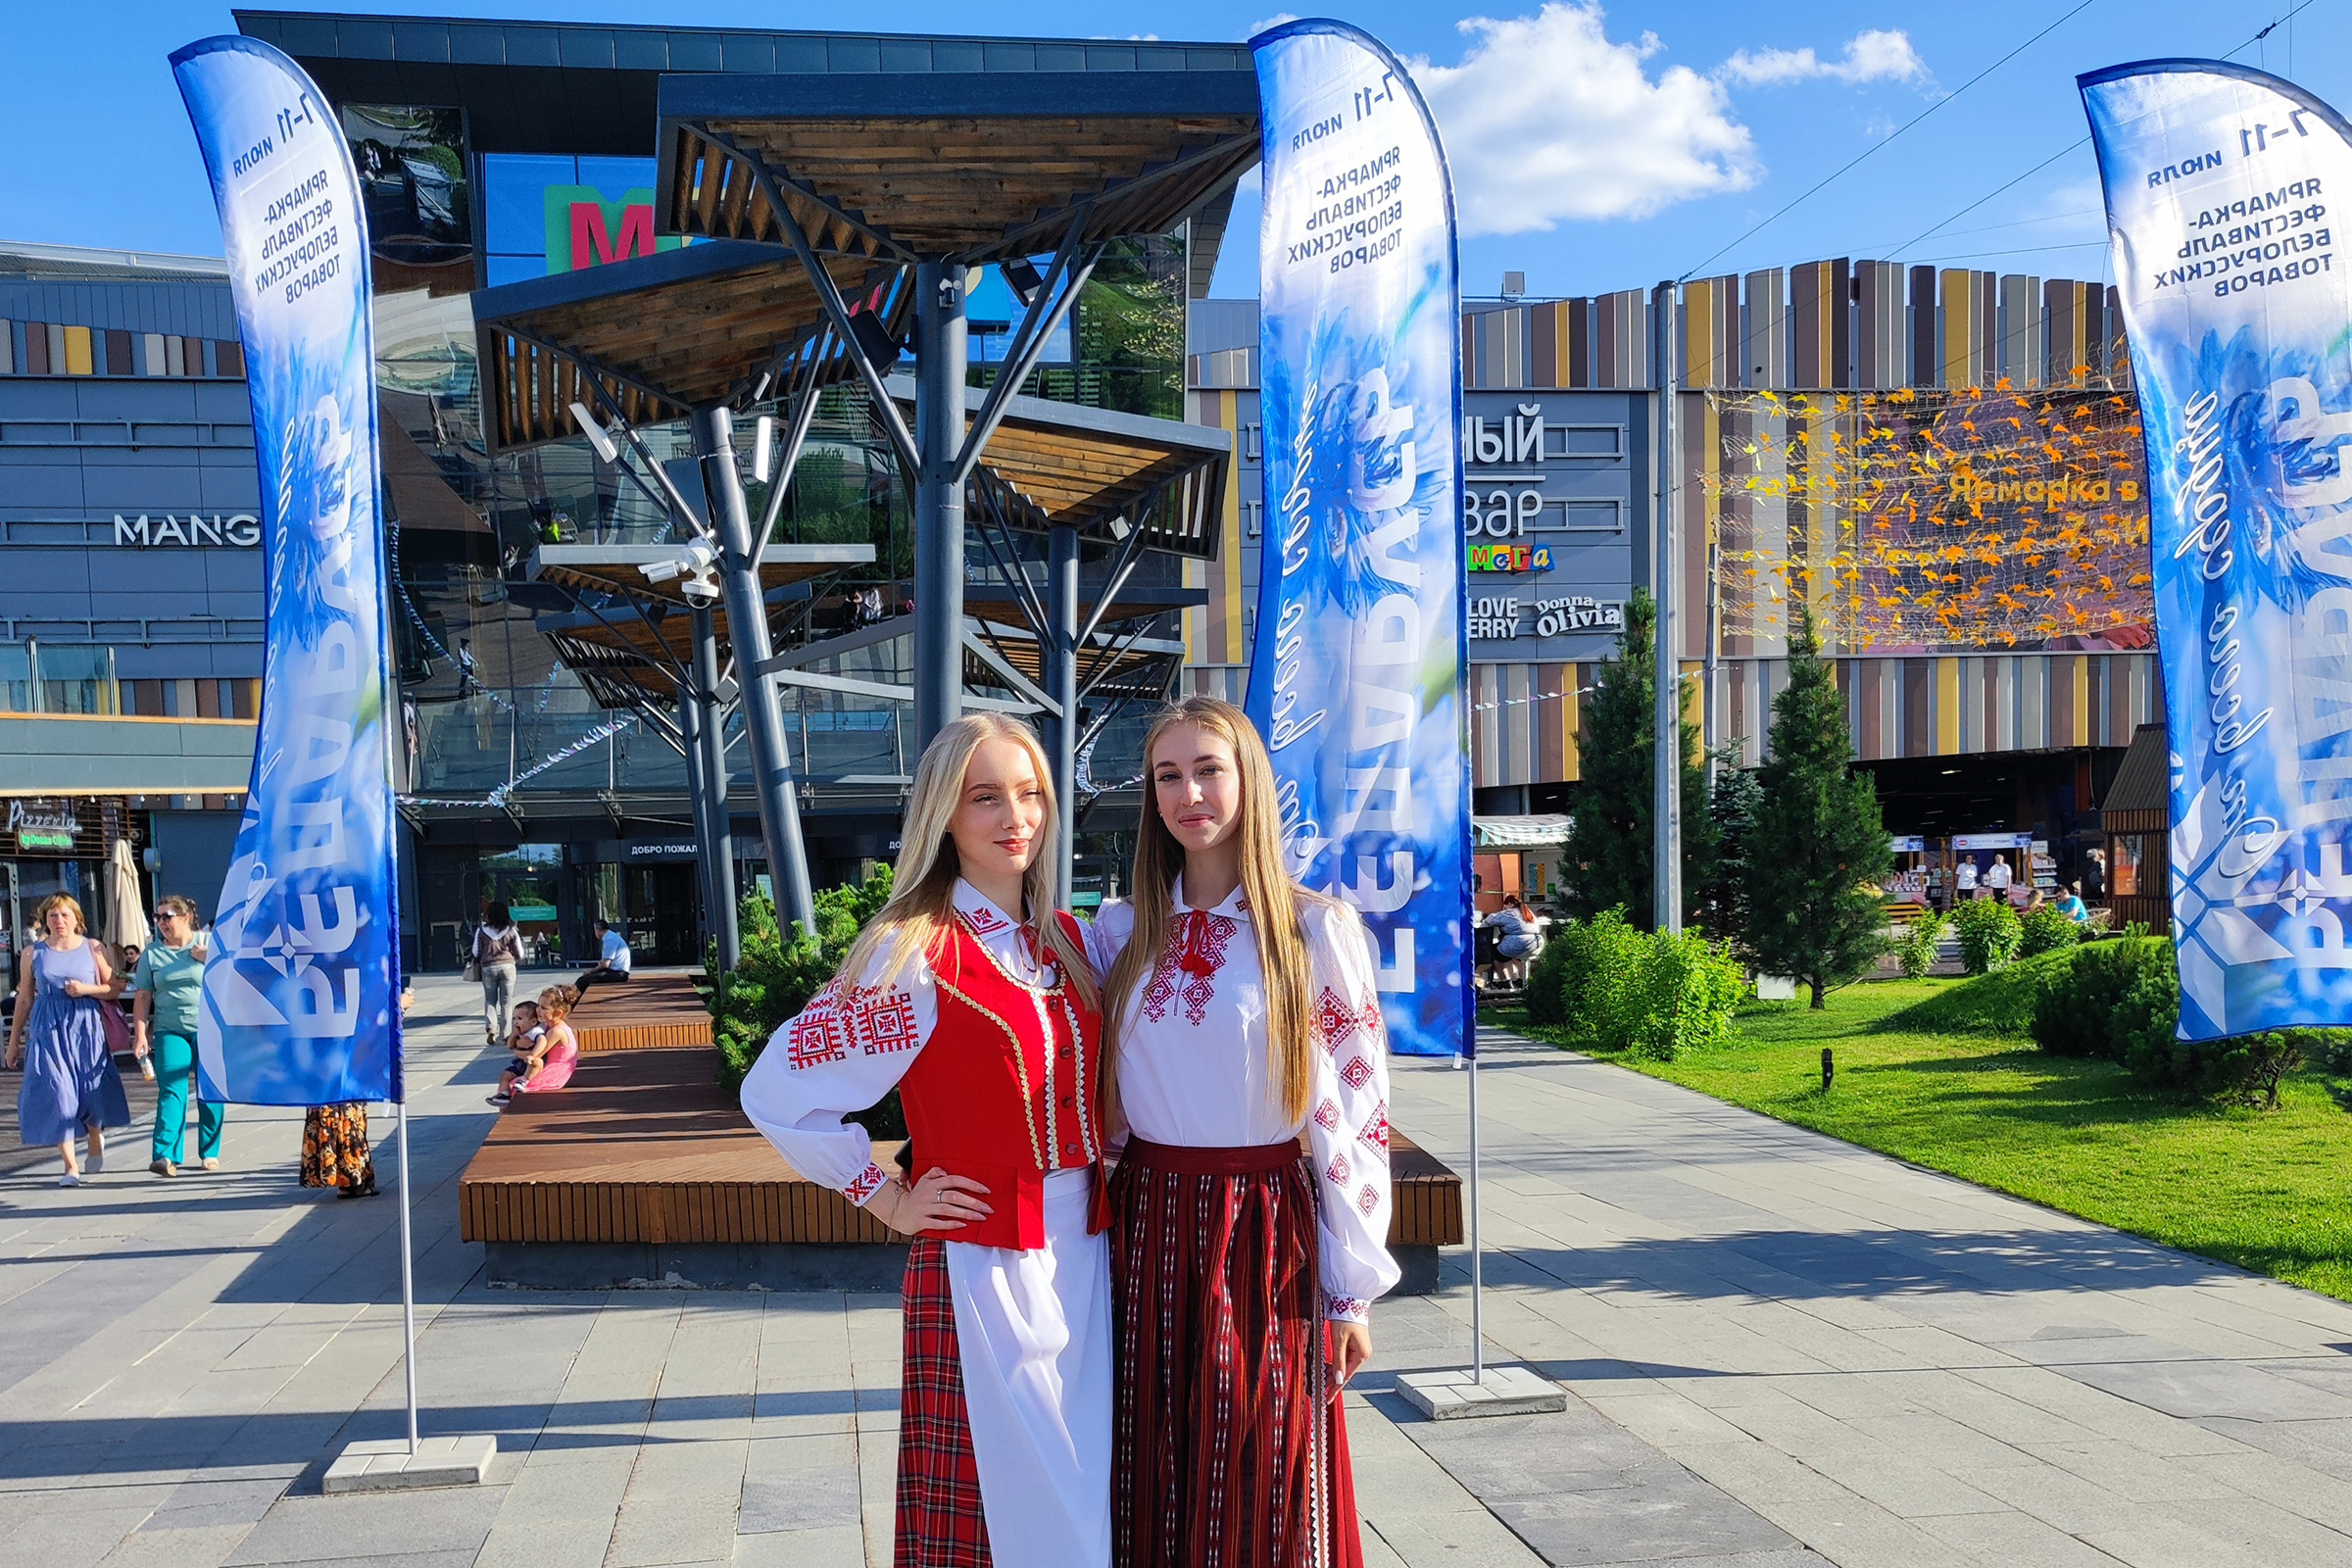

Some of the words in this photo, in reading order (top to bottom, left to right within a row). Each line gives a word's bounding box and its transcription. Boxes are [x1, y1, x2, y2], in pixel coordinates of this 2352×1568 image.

[1948, 472, 2111, 513] Ярмарка
[1535, 595, 1594, 615] Donna
[1537, 602, 1622, 637] Olivia
[631, 845, 662, 856] ДОБРО
